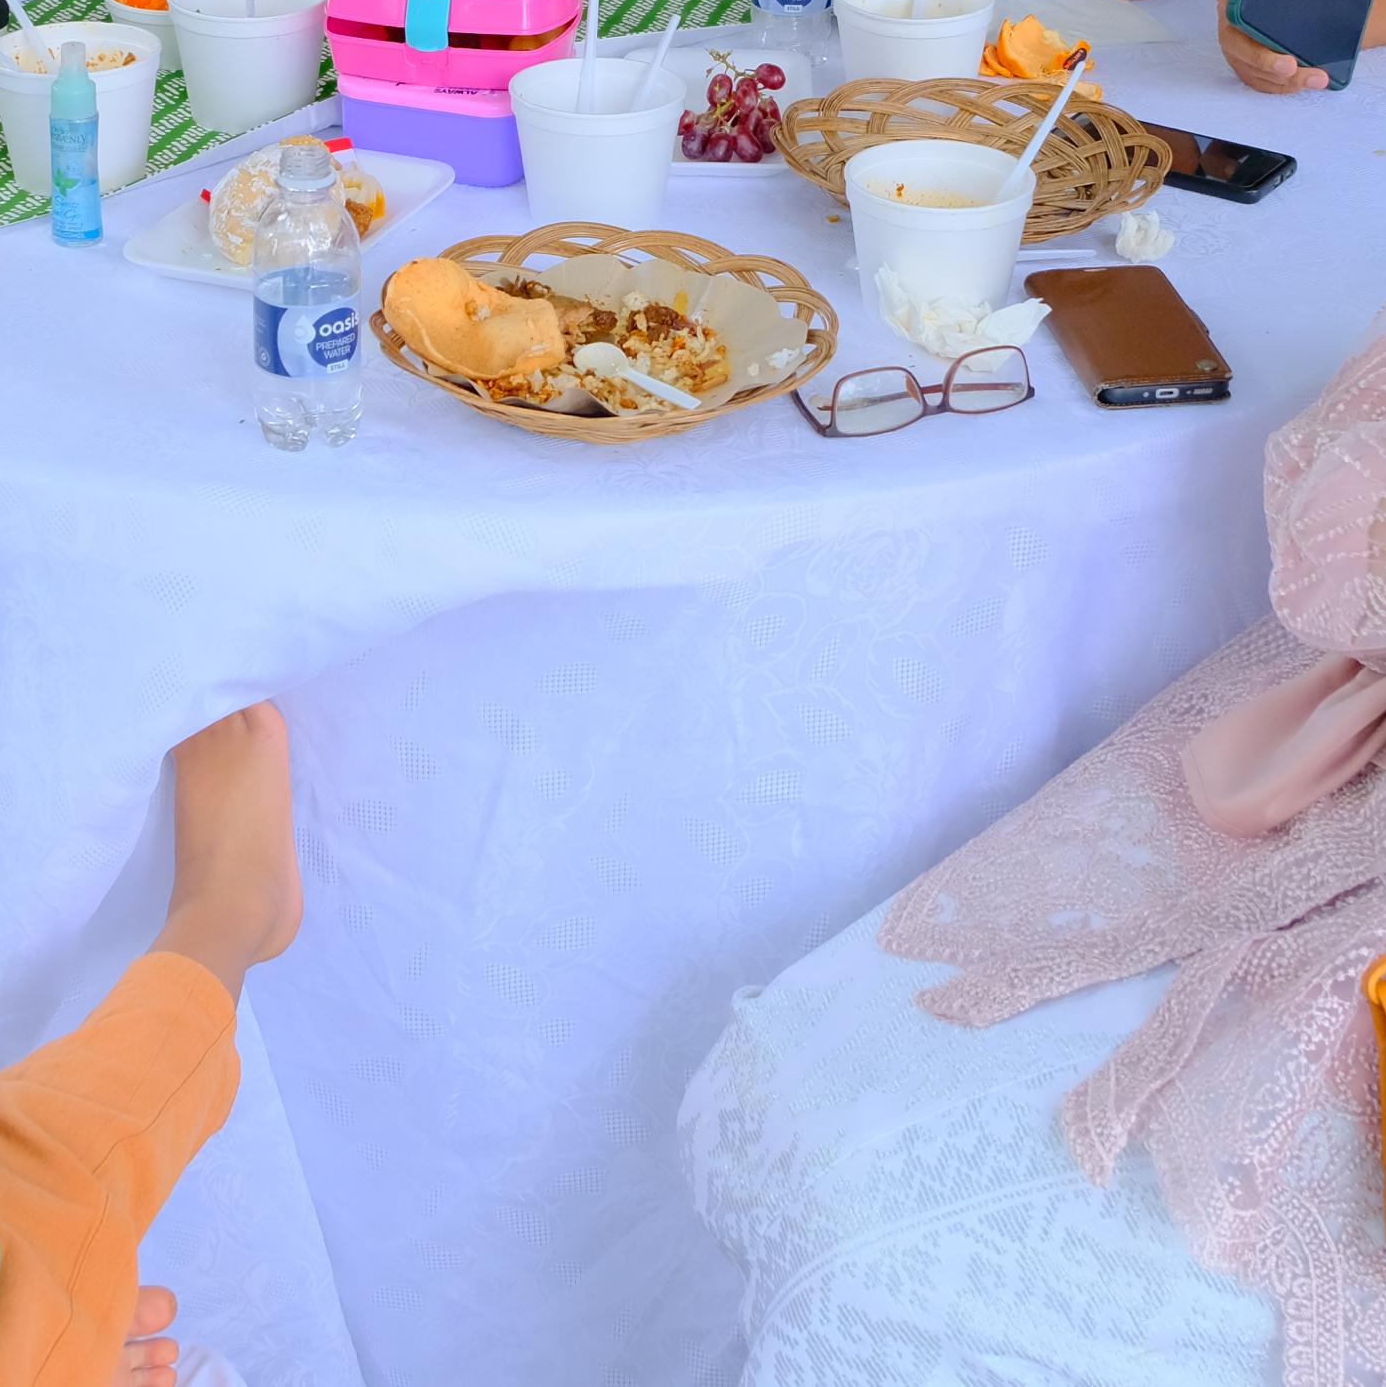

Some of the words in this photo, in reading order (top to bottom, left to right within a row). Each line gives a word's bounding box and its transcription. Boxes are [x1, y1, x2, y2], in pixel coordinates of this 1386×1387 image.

[319, 312, 359, 337] oasis
[316, 333, 355, 351] PREPARED
[324, 345, 350, 359] WATER
